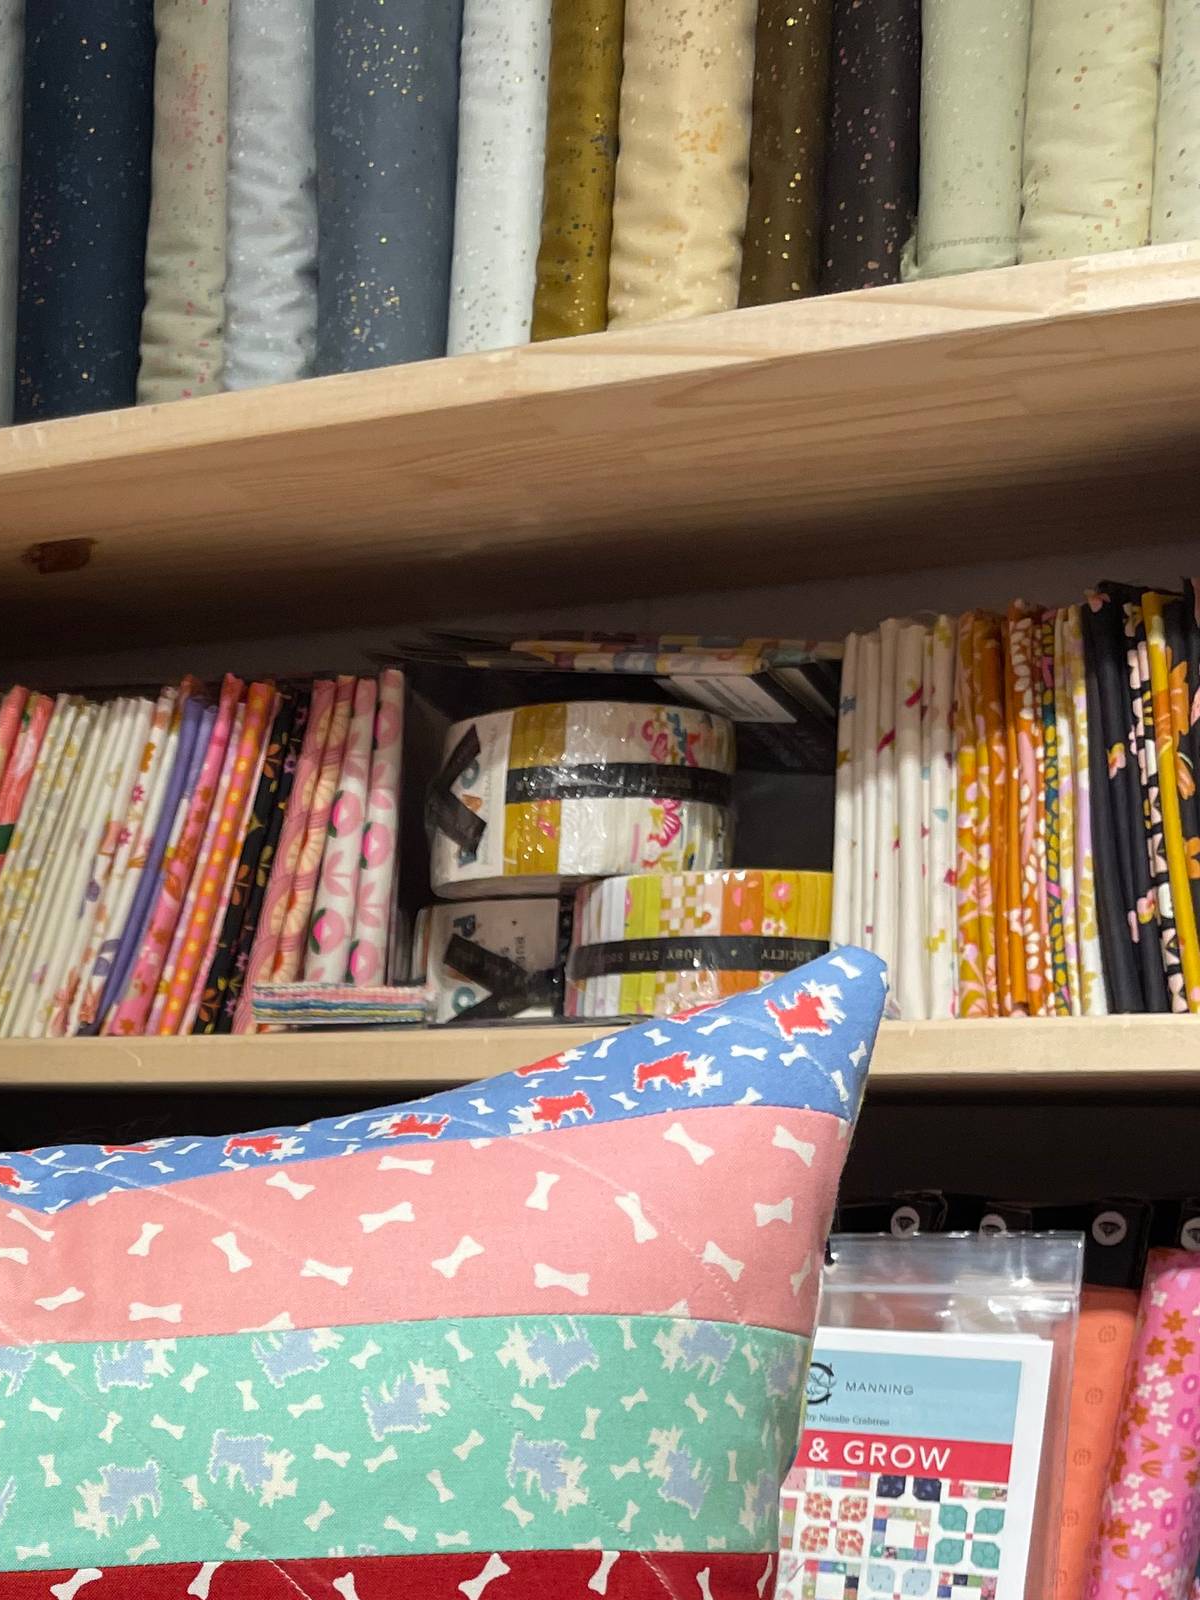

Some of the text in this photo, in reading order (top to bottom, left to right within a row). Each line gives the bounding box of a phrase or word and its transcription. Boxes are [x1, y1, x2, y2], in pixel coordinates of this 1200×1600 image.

[629, 949, 659, 961] STAR
[845, 1381, 915, 1396] MANNING
[808, 1437, 951, 1472] & GROW
